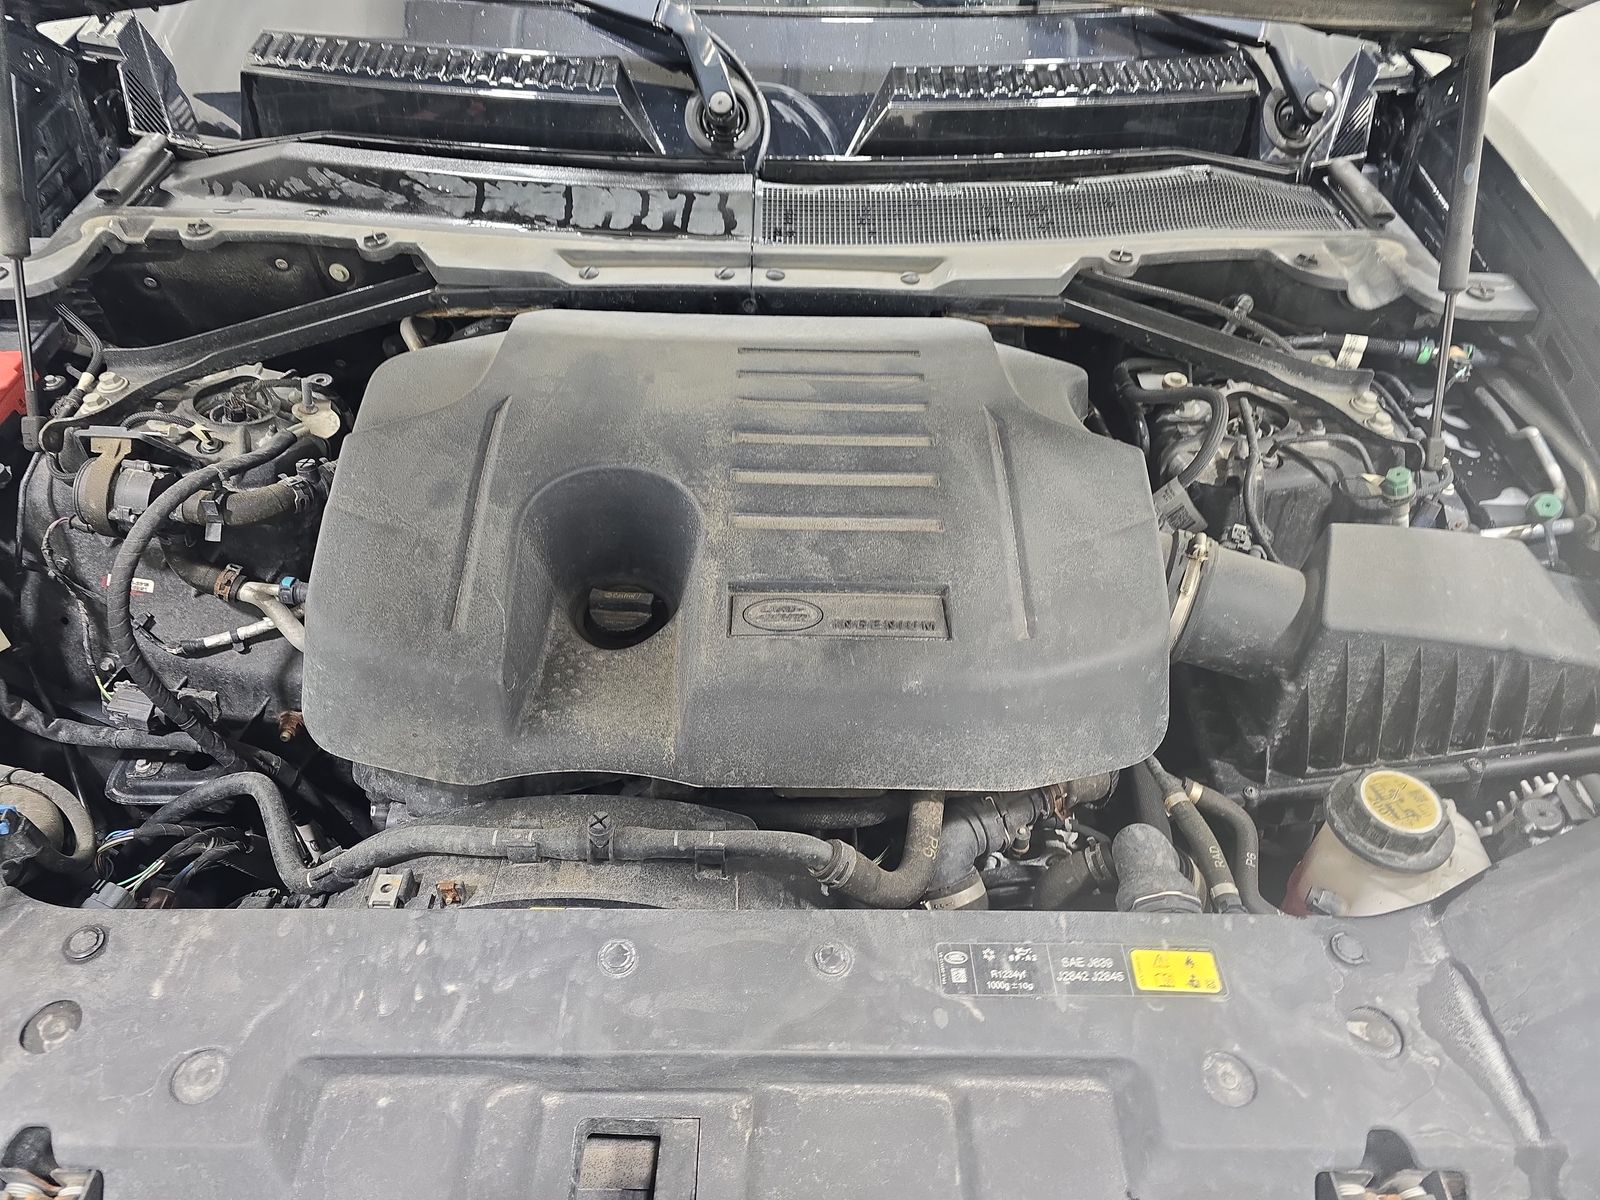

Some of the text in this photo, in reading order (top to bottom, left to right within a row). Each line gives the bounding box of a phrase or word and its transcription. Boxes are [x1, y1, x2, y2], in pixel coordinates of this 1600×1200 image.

[832, 619, 936, 631] INGENIUM
[1208, 845, 1226, 868] RAD
[1245, 852, 1257, 868] P6
[1060, 957, 1085, 968] SAE
